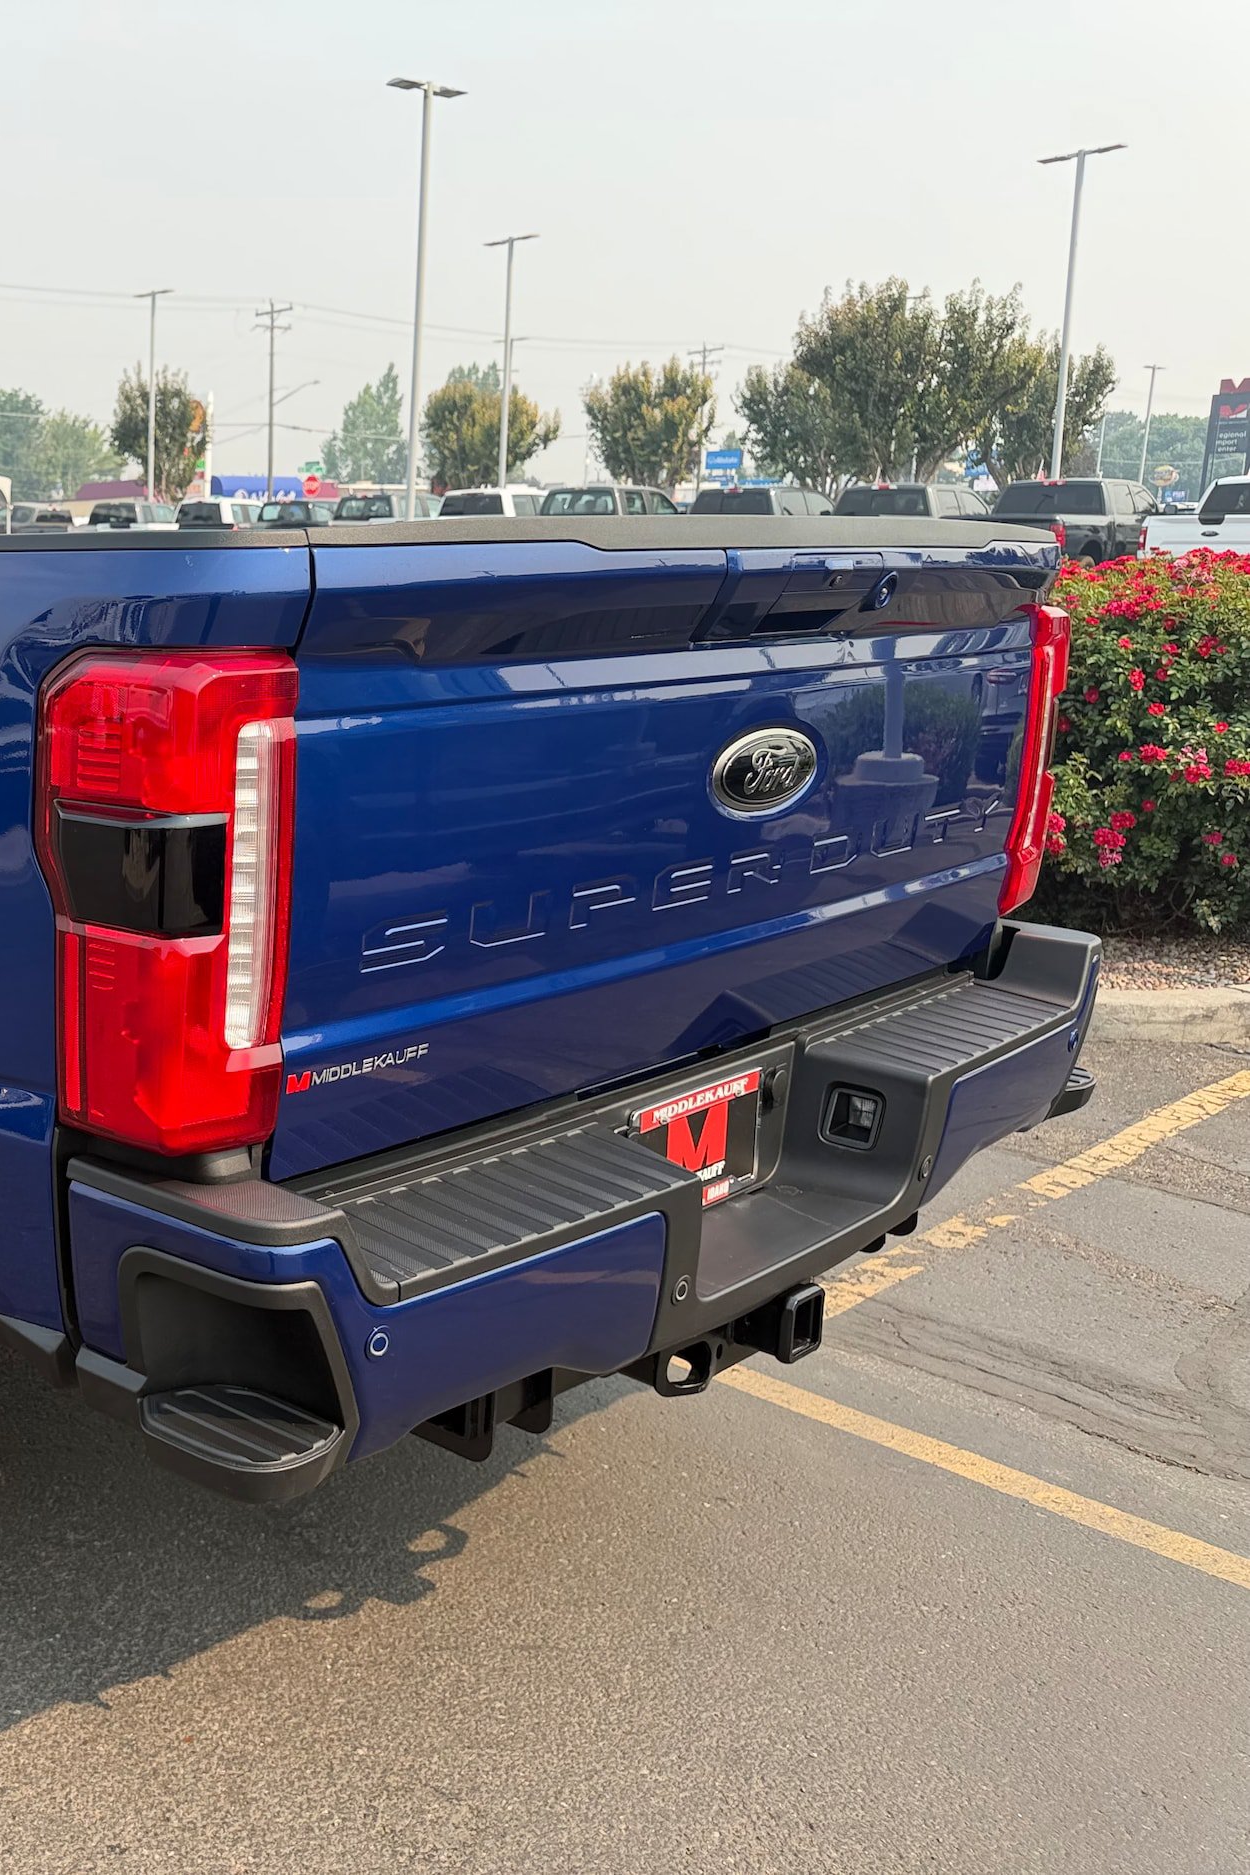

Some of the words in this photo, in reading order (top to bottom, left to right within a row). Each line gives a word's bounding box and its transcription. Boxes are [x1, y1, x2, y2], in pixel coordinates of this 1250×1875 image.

[743, 747, 800, 795] Ford
[359, 851, 782, 973] SUPER
[809, 791, 1001, 875] DUTY
[311, 1042, 430, 1086] MIDDLEKAUFF
[652, 1077, 749, 1125] MIDDLEKAUFF
[666, 1101, 729, 1172] M
